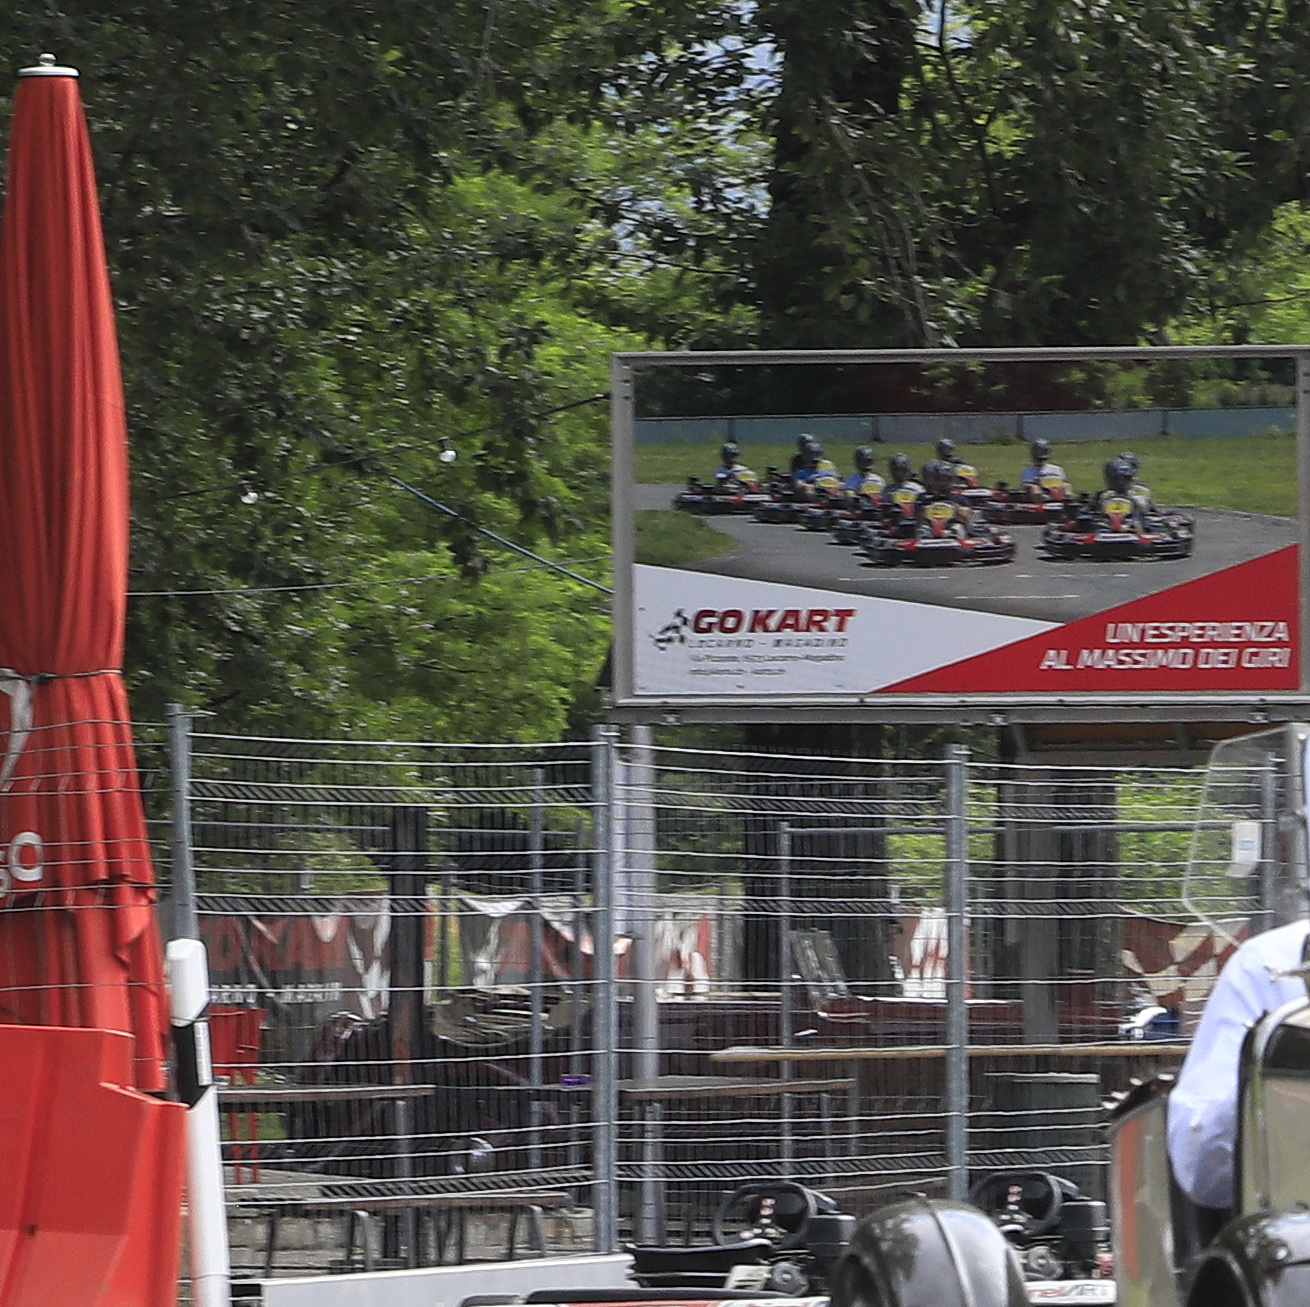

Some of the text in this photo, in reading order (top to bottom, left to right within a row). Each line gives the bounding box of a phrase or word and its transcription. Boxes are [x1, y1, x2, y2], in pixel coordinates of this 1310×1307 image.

[693, 608, 858, 633] GO KART
[1105, 621, 1291, 643] UN'ESPERIENZA
[1039, 647, 1292, 669] AL MASSIMO DEI GIRI
